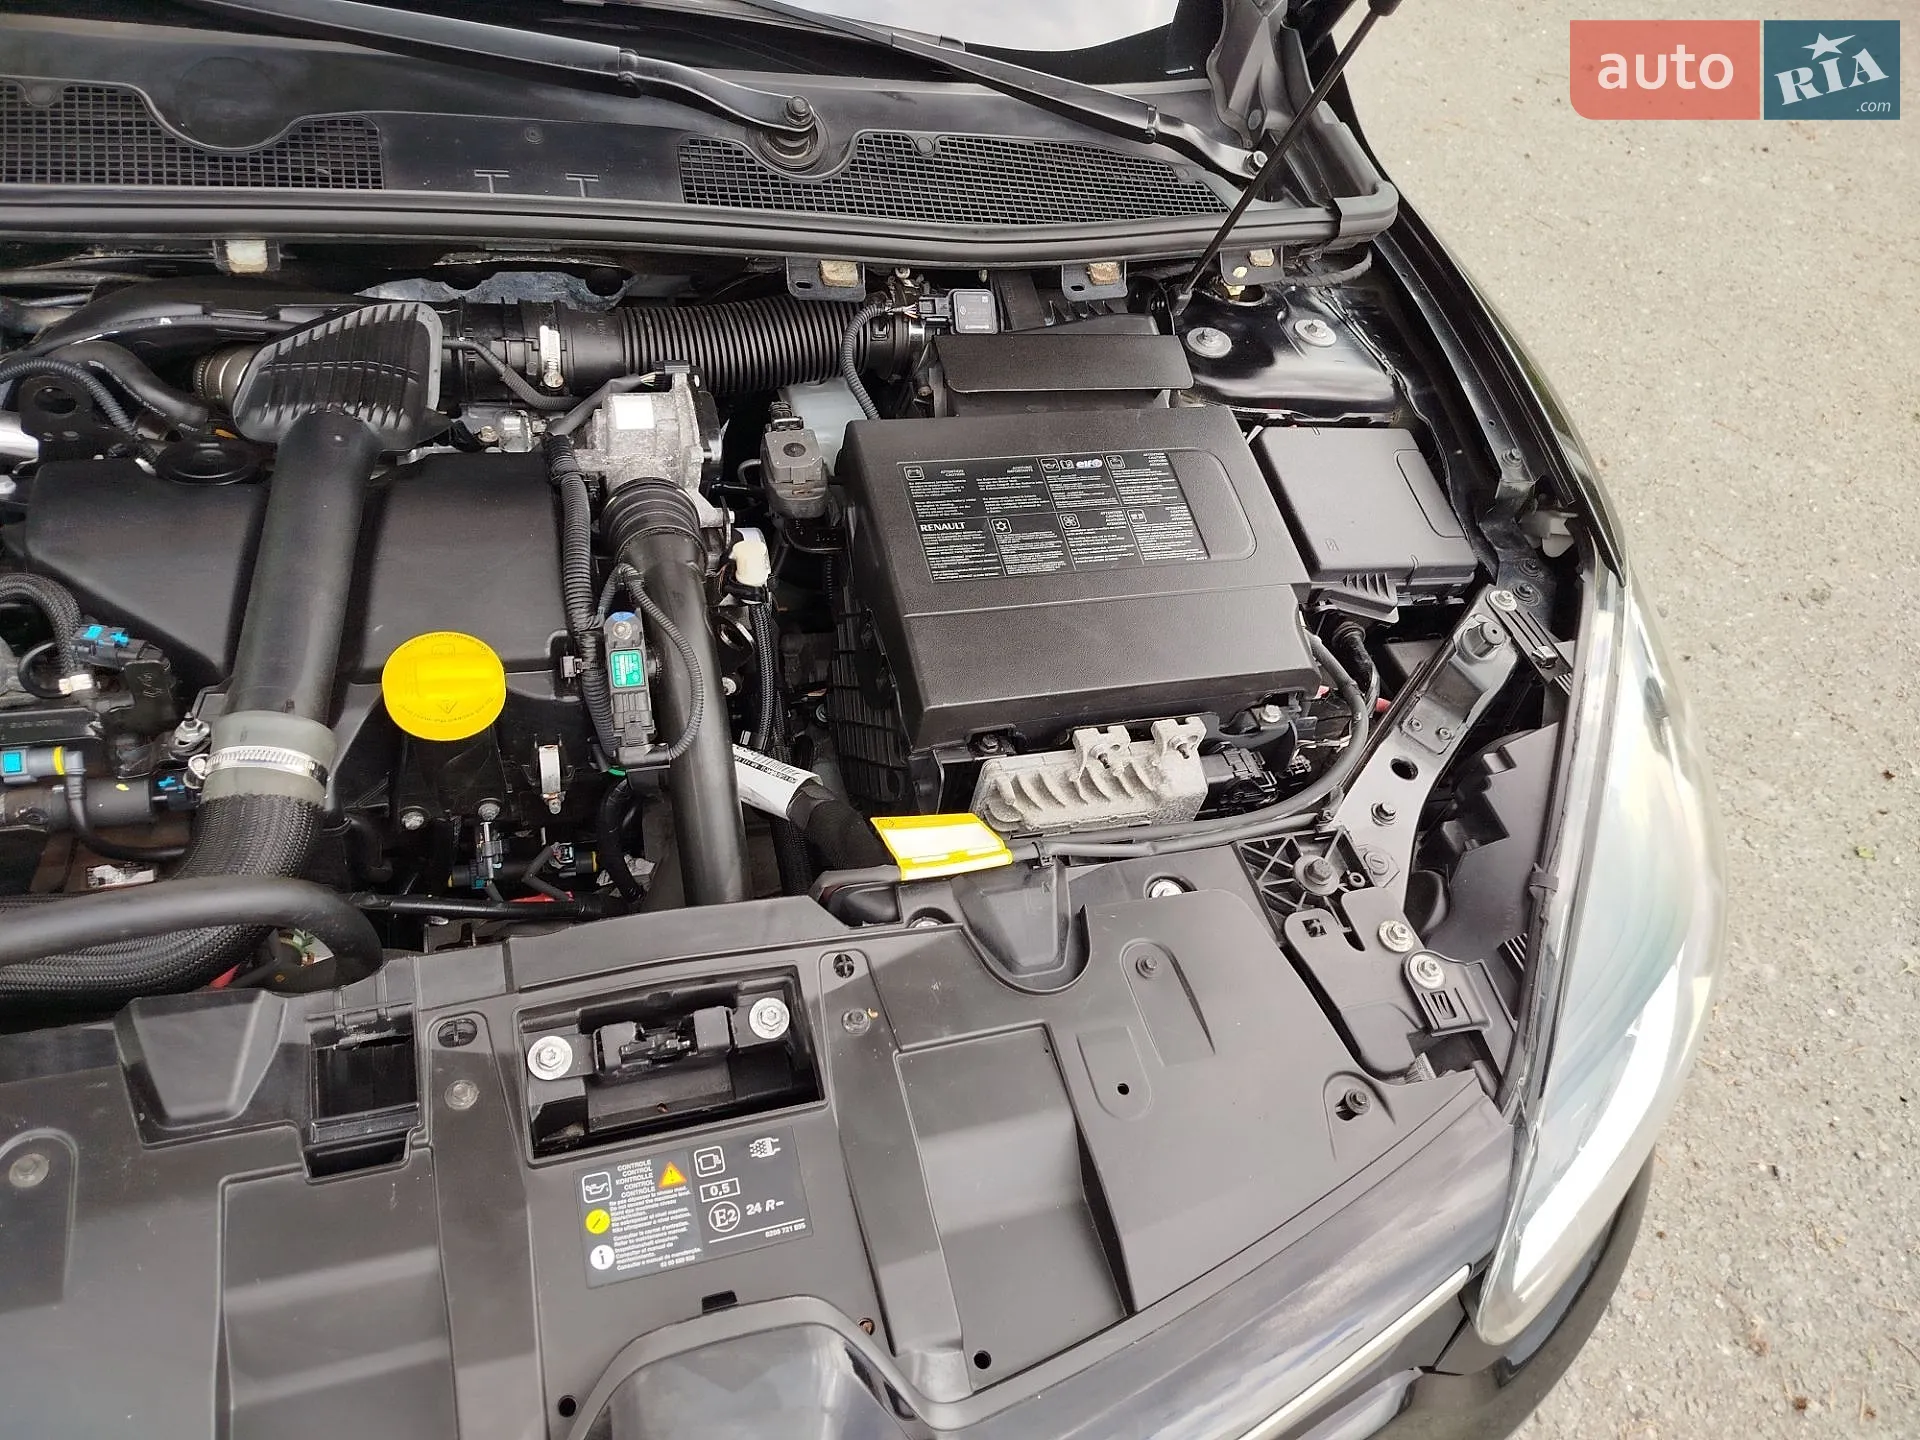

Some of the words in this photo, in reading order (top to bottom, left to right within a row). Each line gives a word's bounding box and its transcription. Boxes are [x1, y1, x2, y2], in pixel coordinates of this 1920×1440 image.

[920, 522, 965, 532] RENAULT
[623, 1166, 652, 1177] CONTROL
[624, 1180, 654, 1190] CONTROL
[710, 1183, 730, 1196] 0,5
[746, 1202, 762, 1216] 24
[713, 1209, 737, 1227] E2
